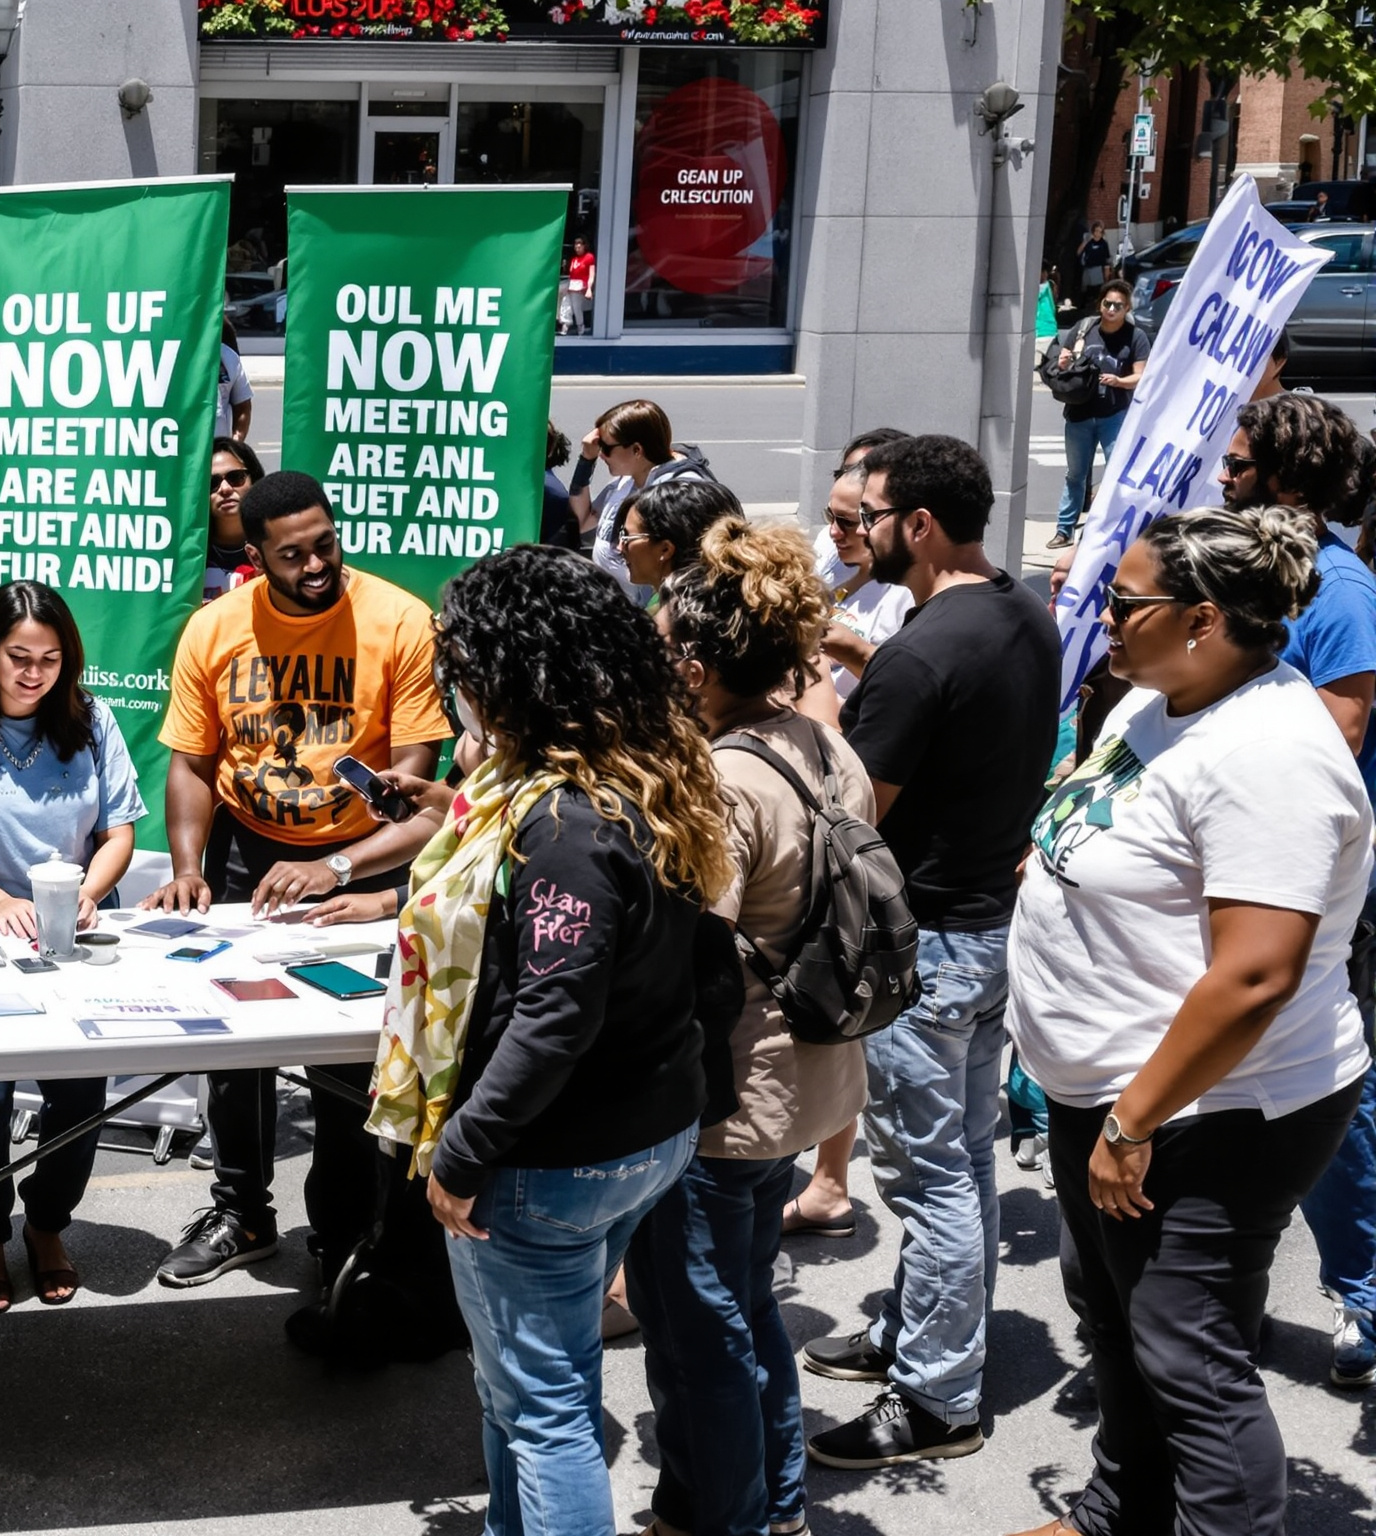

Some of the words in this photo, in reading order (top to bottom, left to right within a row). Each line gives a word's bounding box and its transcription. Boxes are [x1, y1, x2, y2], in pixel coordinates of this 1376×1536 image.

[723, 169, 743, 185] UP
[2, 292, 91, 335] OUL
[106, 290, 167, 333] UF
[336, 284, 422, 324] OUL
[434, 287, 502, 326] ME
[327, 330, 510, 393] NOW
[324, 398, 508, 437] MEETING
[328, 443, 407, 478] ARE
[413, 445, 495, 481] ANL
[83, 469, 167, 507] ANL
[323, 482, 410, 516] FUET
[415, 486, 499, 520] AND
[79, 513, 172, 551] AIND
[334, 521, 392, 554] UR
[398, 523, 506, 558] AIND!
[68, 553, 174, 593] ANID!
